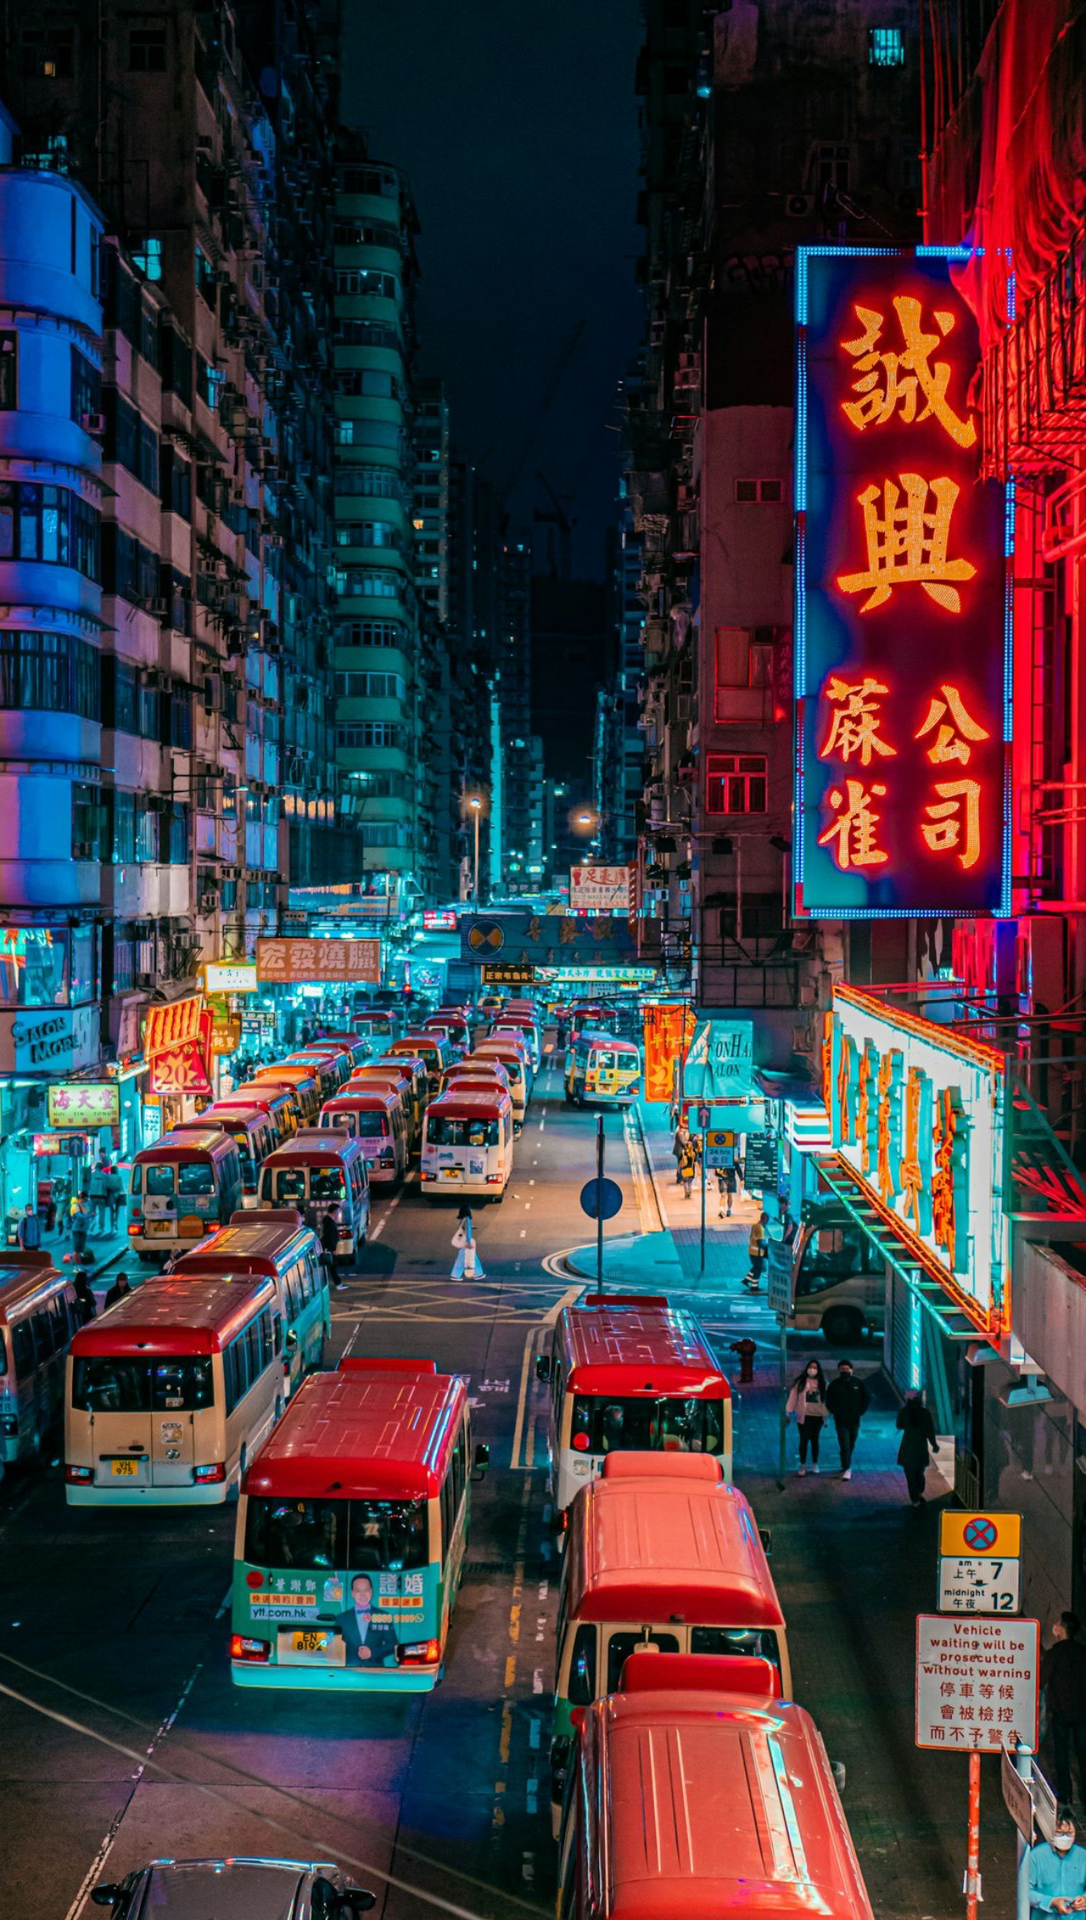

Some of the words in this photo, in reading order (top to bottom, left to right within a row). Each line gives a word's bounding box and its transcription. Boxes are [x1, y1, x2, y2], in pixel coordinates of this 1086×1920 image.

[837, 295, 977, 614] 誠興
[915, 685, 990, 869] 公司
[260, 941, 376, 969] 宏發燒臘
[11, 1016, 67, 1048] SALON
[31, 1034, 80, 1064] MORE
[161, 1064, 188, 1085] 20
[714, 1063, 741, 1077] ALON
[52, 1088, 117, 1111] 海天堂
[709, 1148, 719, 1156] 24
[720, 1148, 731, 1156] hrs
[711, 1156, 729, 1164] 全日
[953, 1568, 977, 1579] 上午
[990, 1562, 1003, 1580] 7
[379, 1573, 423, 1595] 證婚
[944, 1588, 985, 1598] midnight
[991, 1592, 1014, 1610] 12
[952, 1599, 976, 1609] 午夜
[303, 1633, 317, 1641] EN
[953, 1623, 1002, 1636] Vehicle
[297, 1641, 323, 1651] 8192
[930, 1637, 979, 1651] waiting
[983, 1640, 1006, 1650] will
[1009, 1641, 1025, 1651] be
[940, 1652, 1014, 1665] prosecuted
[922, 1664, 974, 1677] without
[978, 1667, 1031, 1681] warning
[940, 1681, 1014, 1700] 停車等候
[940, 1704, 1014, 1723] 會被檢控
[930, 1725, 1023, 1746] 而不予警告
